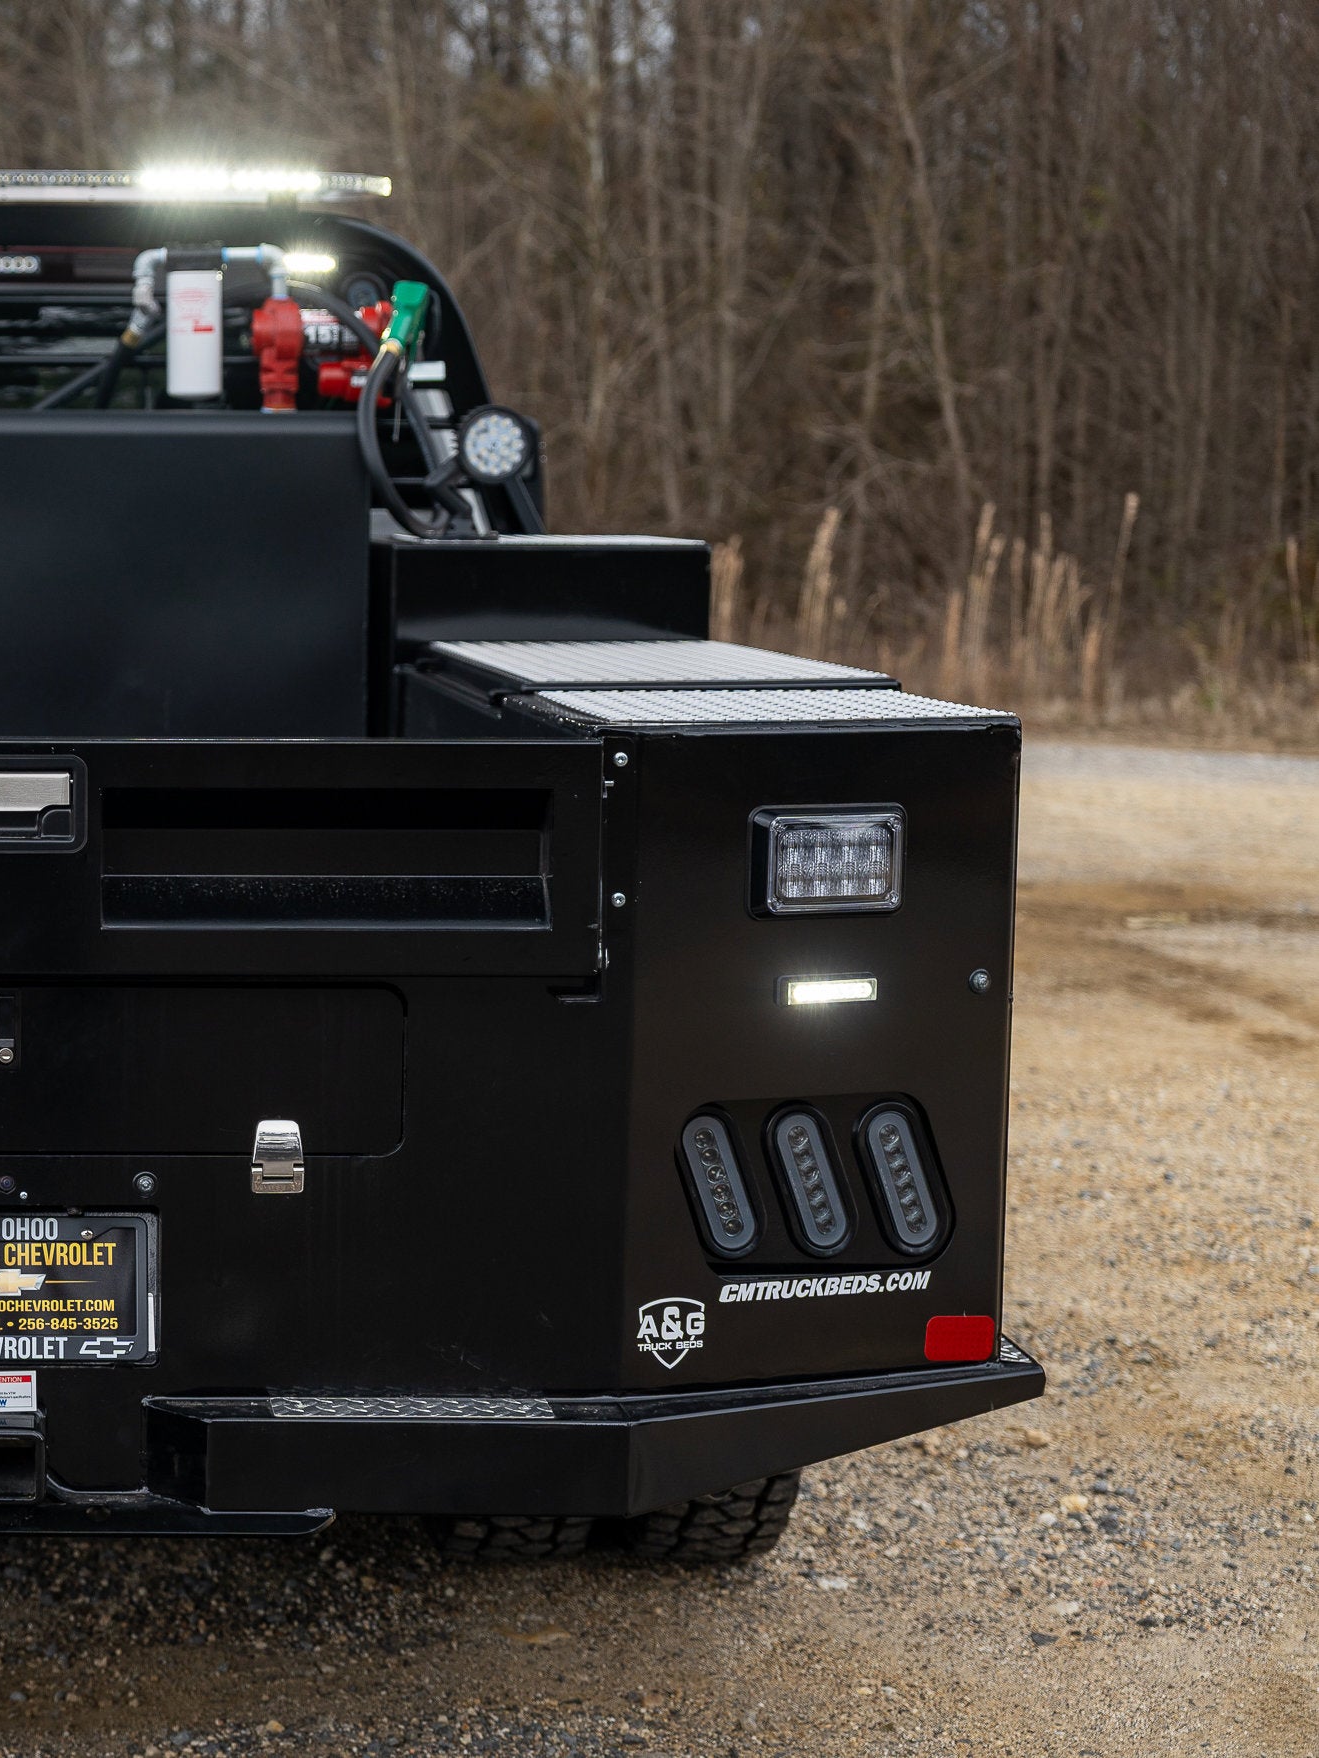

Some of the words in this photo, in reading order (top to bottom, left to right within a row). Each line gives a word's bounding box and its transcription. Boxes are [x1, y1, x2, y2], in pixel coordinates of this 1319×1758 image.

[3, 1242, 117, 1267] CHEVROLET
[718, 1270, 932, 1303] CMTRUCKBEDS.COM
[18, 1317, 119, 1330] 256-845-3525
[636, 1306, 705, 1341] A&G
[637, 1341, 673, 1352] TRUCK
[675, 1340, 704, 1350] BEDS
